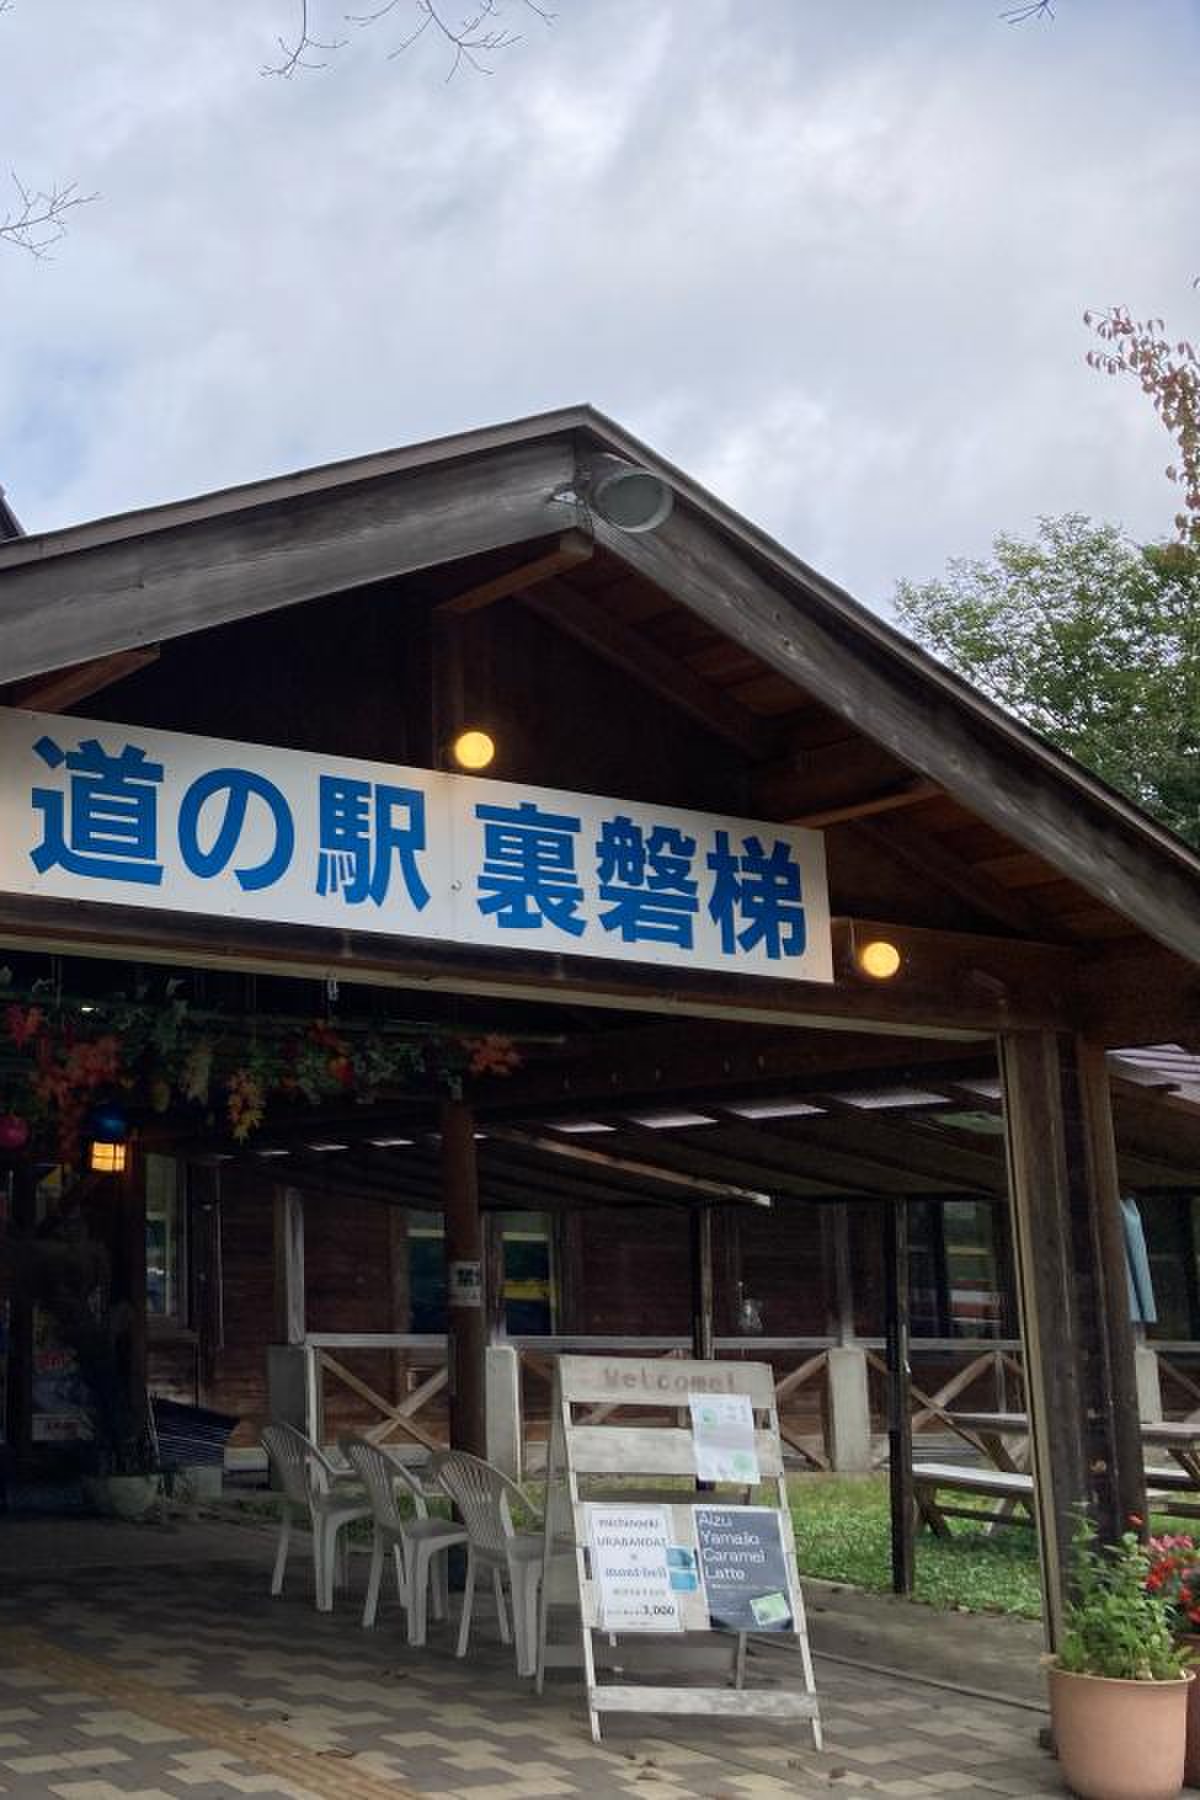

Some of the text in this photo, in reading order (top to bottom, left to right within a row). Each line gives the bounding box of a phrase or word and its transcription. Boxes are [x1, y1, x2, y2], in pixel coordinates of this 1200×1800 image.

[30, 735, 806, 961] 道の駅 裏磐梯
